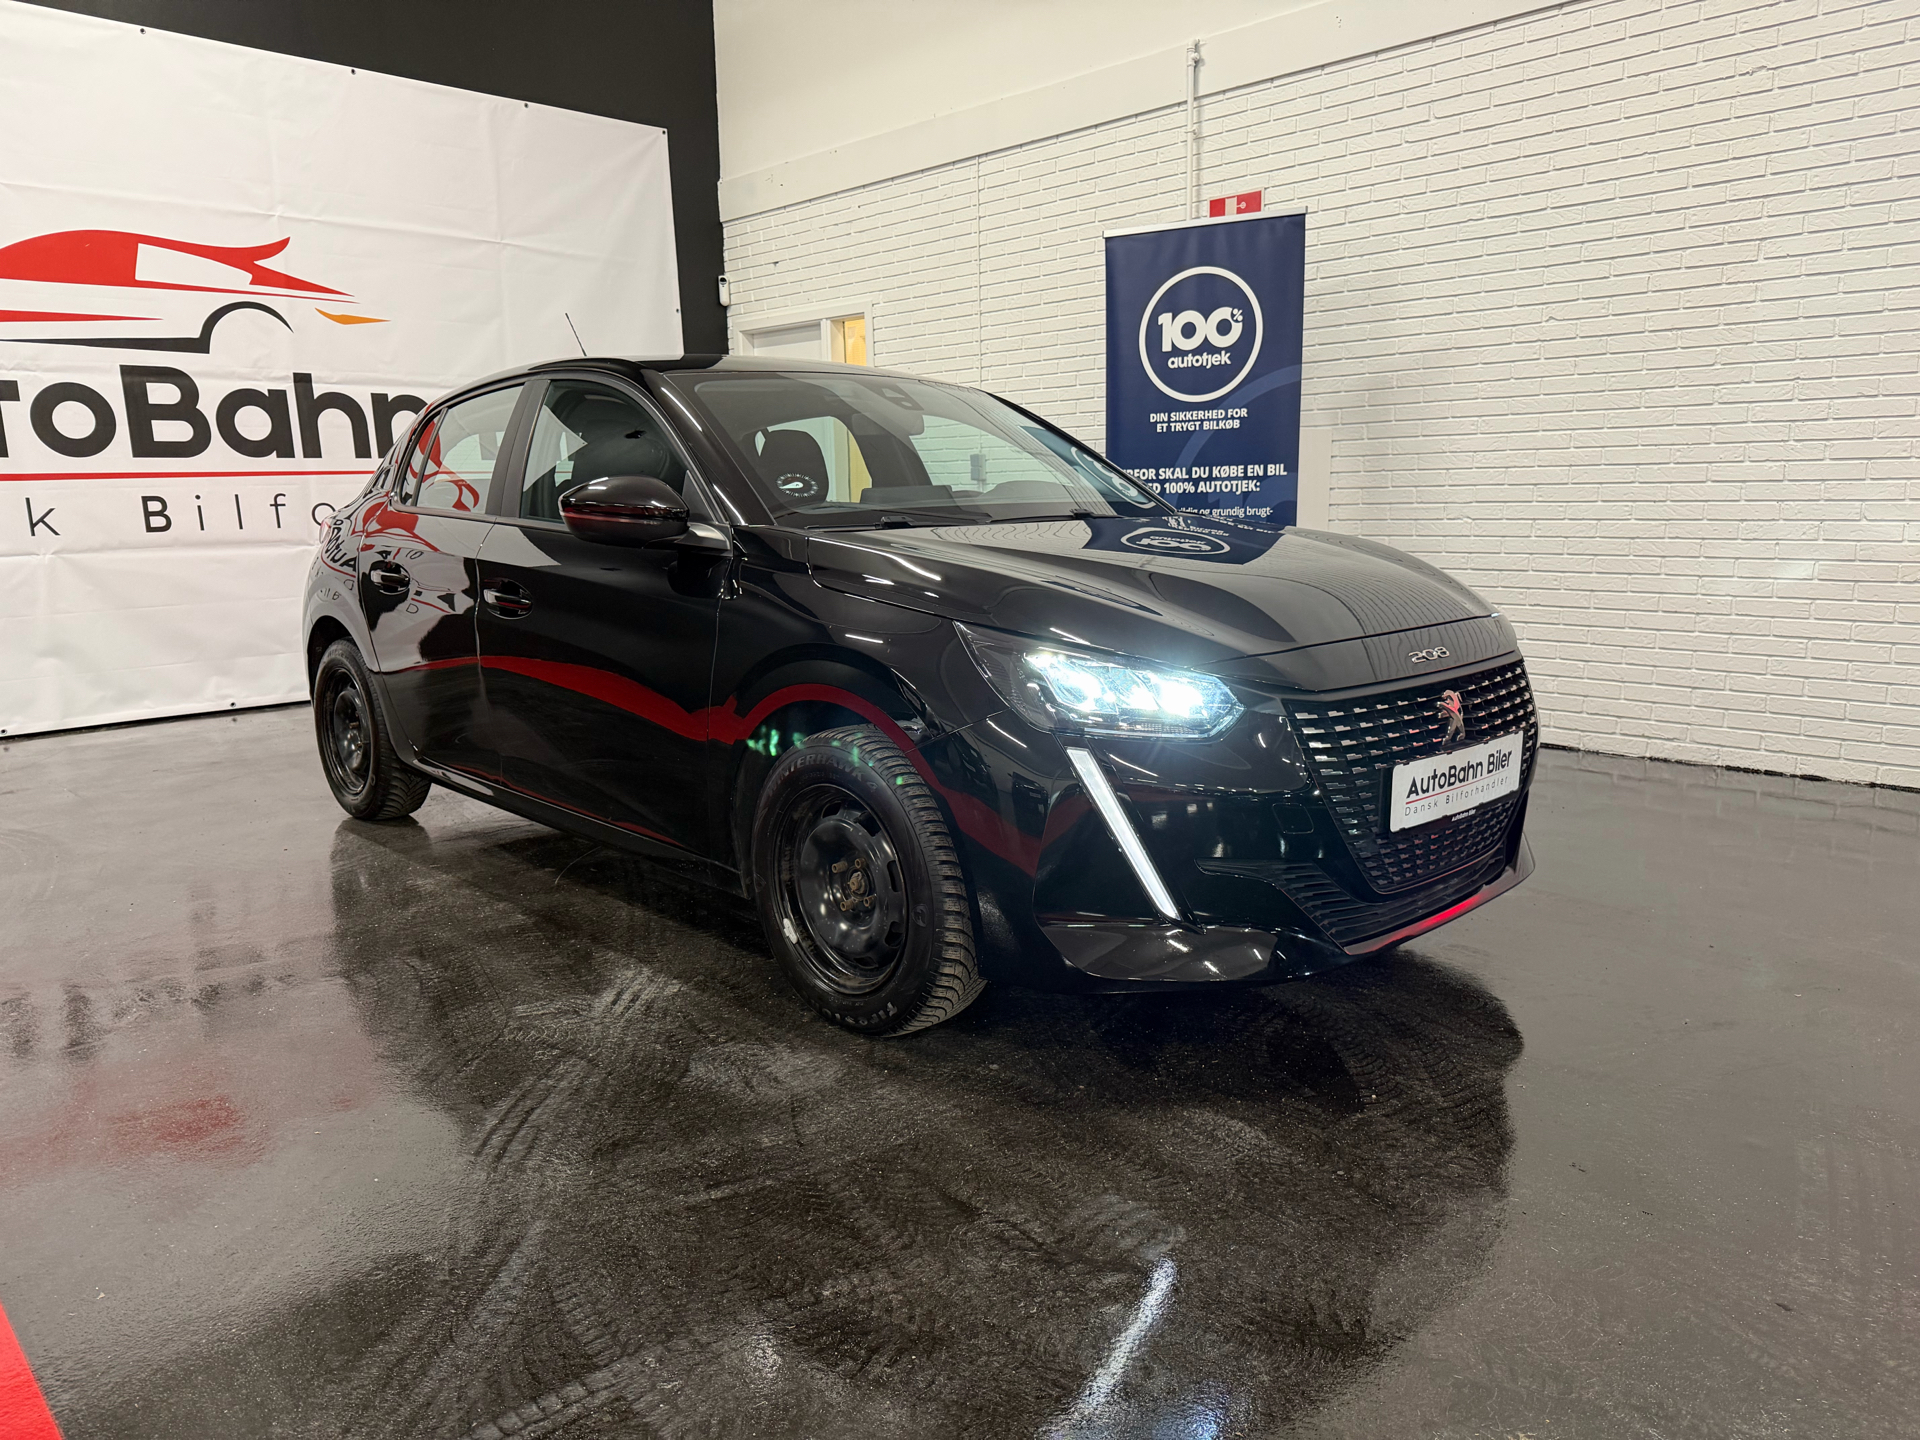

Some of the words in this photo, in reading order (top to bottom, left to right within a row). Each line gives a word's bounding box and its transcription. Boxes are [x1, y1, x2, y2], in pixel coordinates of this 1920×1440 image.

[1167, 350, 1231, 369] autotjek
[1149, 412, 1168, 423] DIN
[1170, 409, 1225, 421] SIKKERHED
[1227, 407, 1248, 418] FOR
[1156, 423, 1168, 433] ET
[1170, 421, 1201, 432] TRYGT
[1203, 418, 1240, 430] BILKØB
[1158, 467, 1189, 480] SKAL
[1191, 466, 1210, 479] DU
[1212, 465, 1244, 478] KØBE
[1246, 464, 1264, 477] EN
[1267, 463, 1288, 476] BIL
[1163, 481, 1196, 494] 100%
[1197, 479, 1261, 495] AUTOTJEK:
[25, 496, 61, 537] k
[1211, 506, 1245, 518] grundig
[1246, 505, 1274, 518] brugt-
[1408, 646, 1450, 664] 208
[1406, 760, 1483, 799] AutoBahn
[1487, 748, 1512, 774] Biler
[1405, 800, 1438, 816] Dansk
[1446, 776, 1508, 804] Bilforhandler
